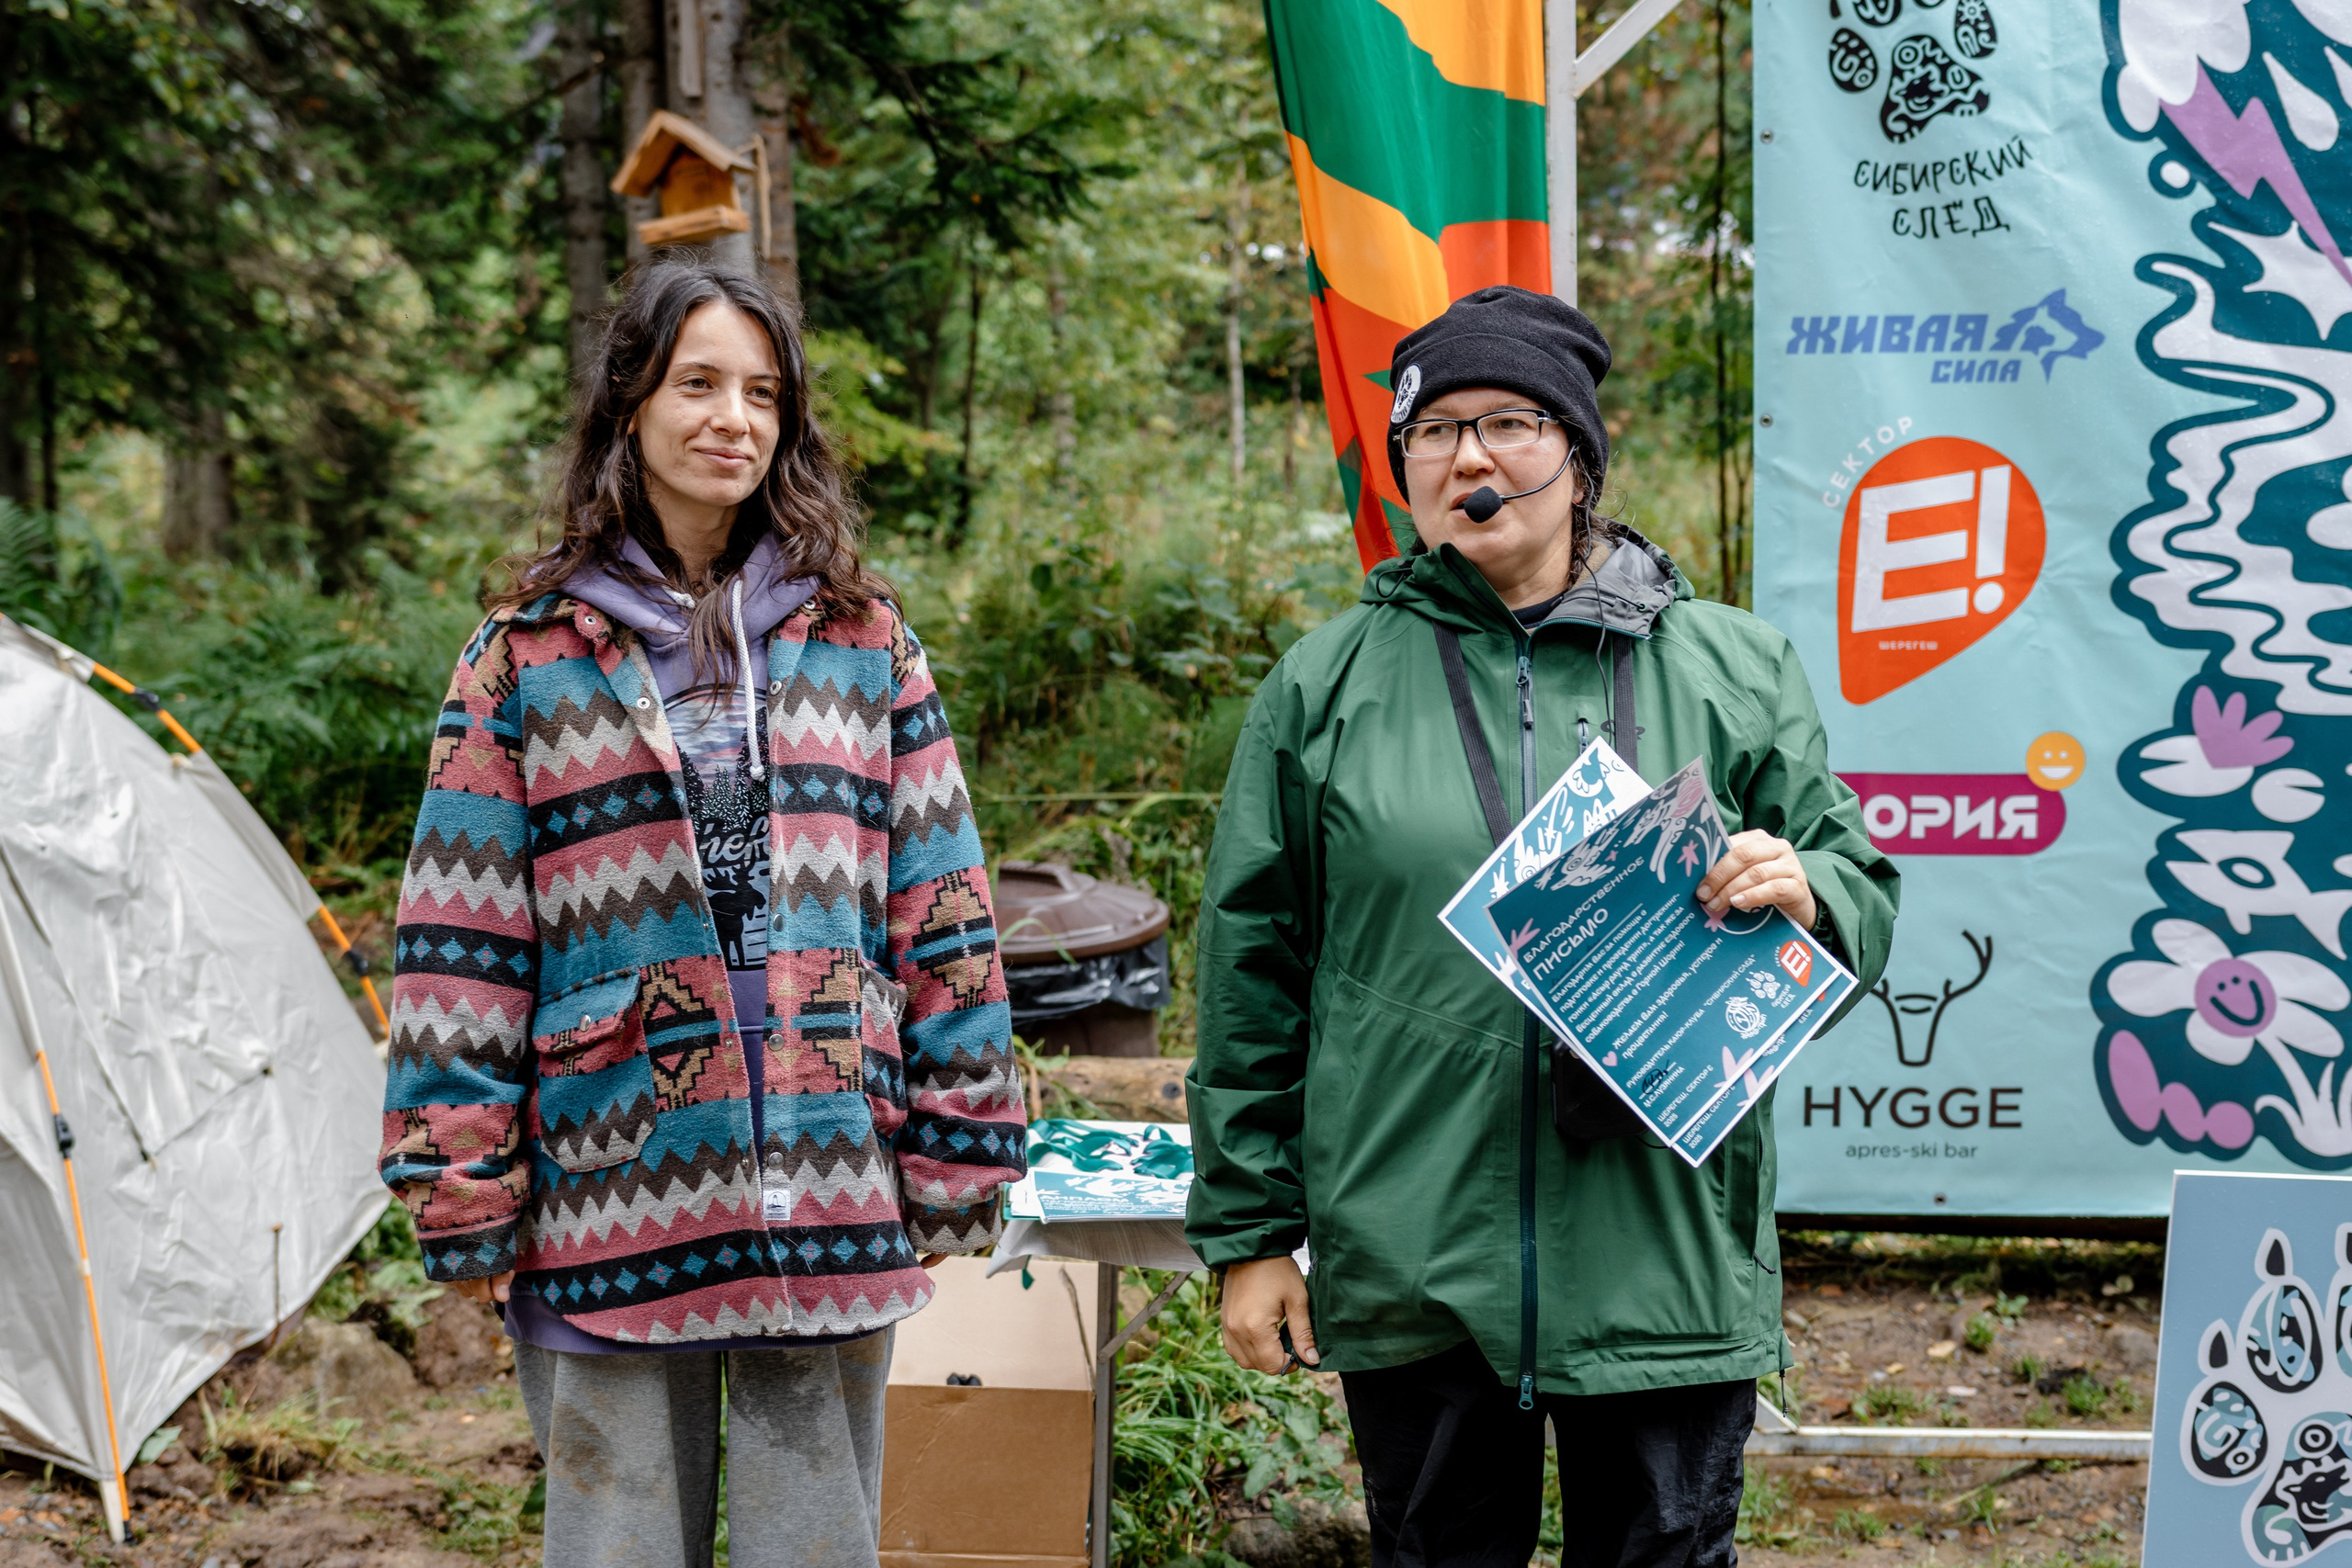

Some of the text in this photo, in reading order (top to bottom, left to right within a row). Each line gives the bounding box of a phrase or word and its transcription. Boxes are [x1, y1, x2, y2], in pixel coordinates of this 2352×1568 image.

[1853, 134, 2034, 195] СИБИРСКИЙ
[1785, 313, 1989, 355] ЖИВАЯ
[1929, 359, 2020, 385] СИЛА
[1822, 415, 1914, 509] СЕКТОР
[1878, 639, 1939, 650] ШЕРЕГЕШ
[1864, 794, 2039, 840] ОРИЯ
[1523, 856, 1645, 964] БЛАГОДАРСТВЕННОЕ
[1532, 908, 1608, 981] ПИСЬМО
[1686, 1069, 1709, 1092] СЕКТОР
[1804, 1086, 2023, 1130] HYGGE
[1845, 1142, 1979, 1160] apres-ski bar
